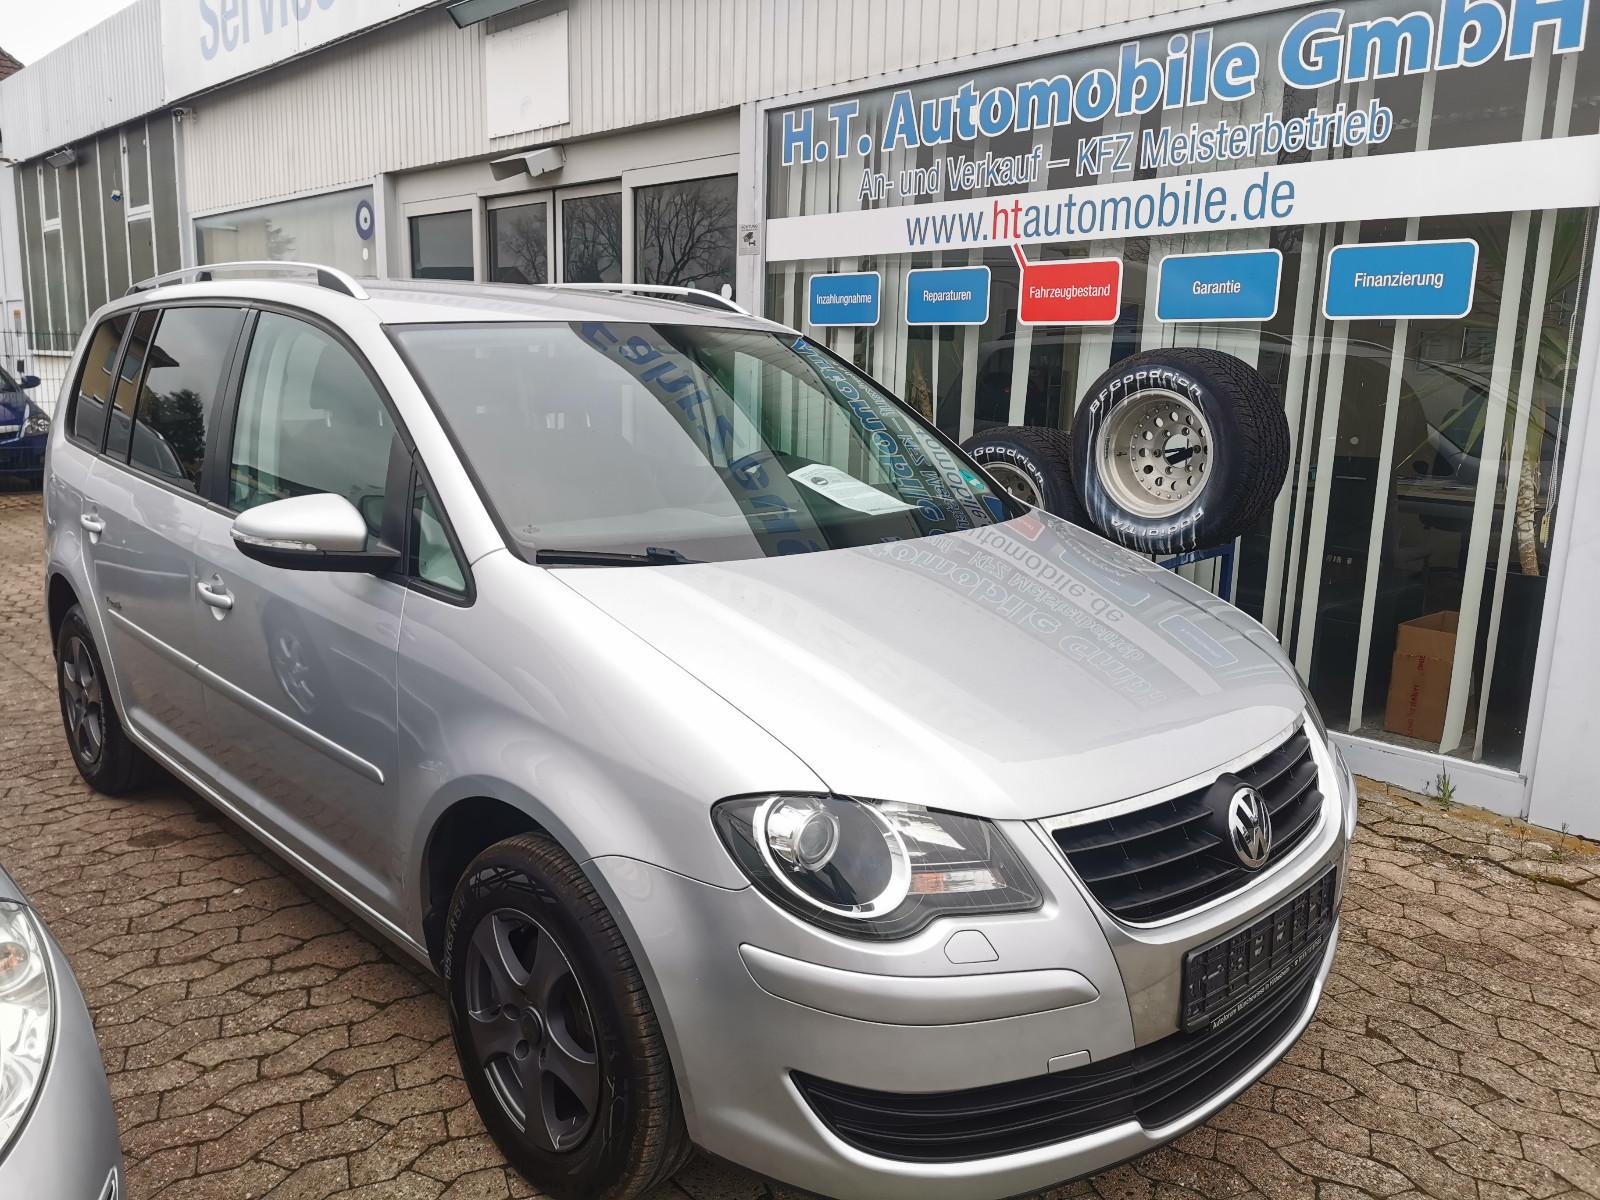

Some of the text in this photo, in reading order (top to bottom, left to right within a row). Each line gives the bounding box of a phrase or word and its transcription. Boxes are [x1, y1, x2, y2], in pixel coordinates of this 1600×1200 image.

[781, 0, 1589, 167] H.T. Automobile GmbH
[857, 167, 894, 202] An-
[899, 159, 942, 198] und
[946, 145, 1043, 191] Verkauf
[1075, 132, 1136, 177] KFZ
[1140, 98, 1394, 169] Meisterbetrieb
[905, 171, 1296, 247] www.htautomobile.de
[1192, 279, 1241, 295] Garantie
[1353, 271, 1444, 289] Finanzierung
[815, 291, 873, 306] Inzahlungnahme
[922, 287, 972, 303] Reparaturen
[1028, 284, 1111, 300] Fahrzeugbestand
[1089, 369, 1202, 414] BFGoodrich
